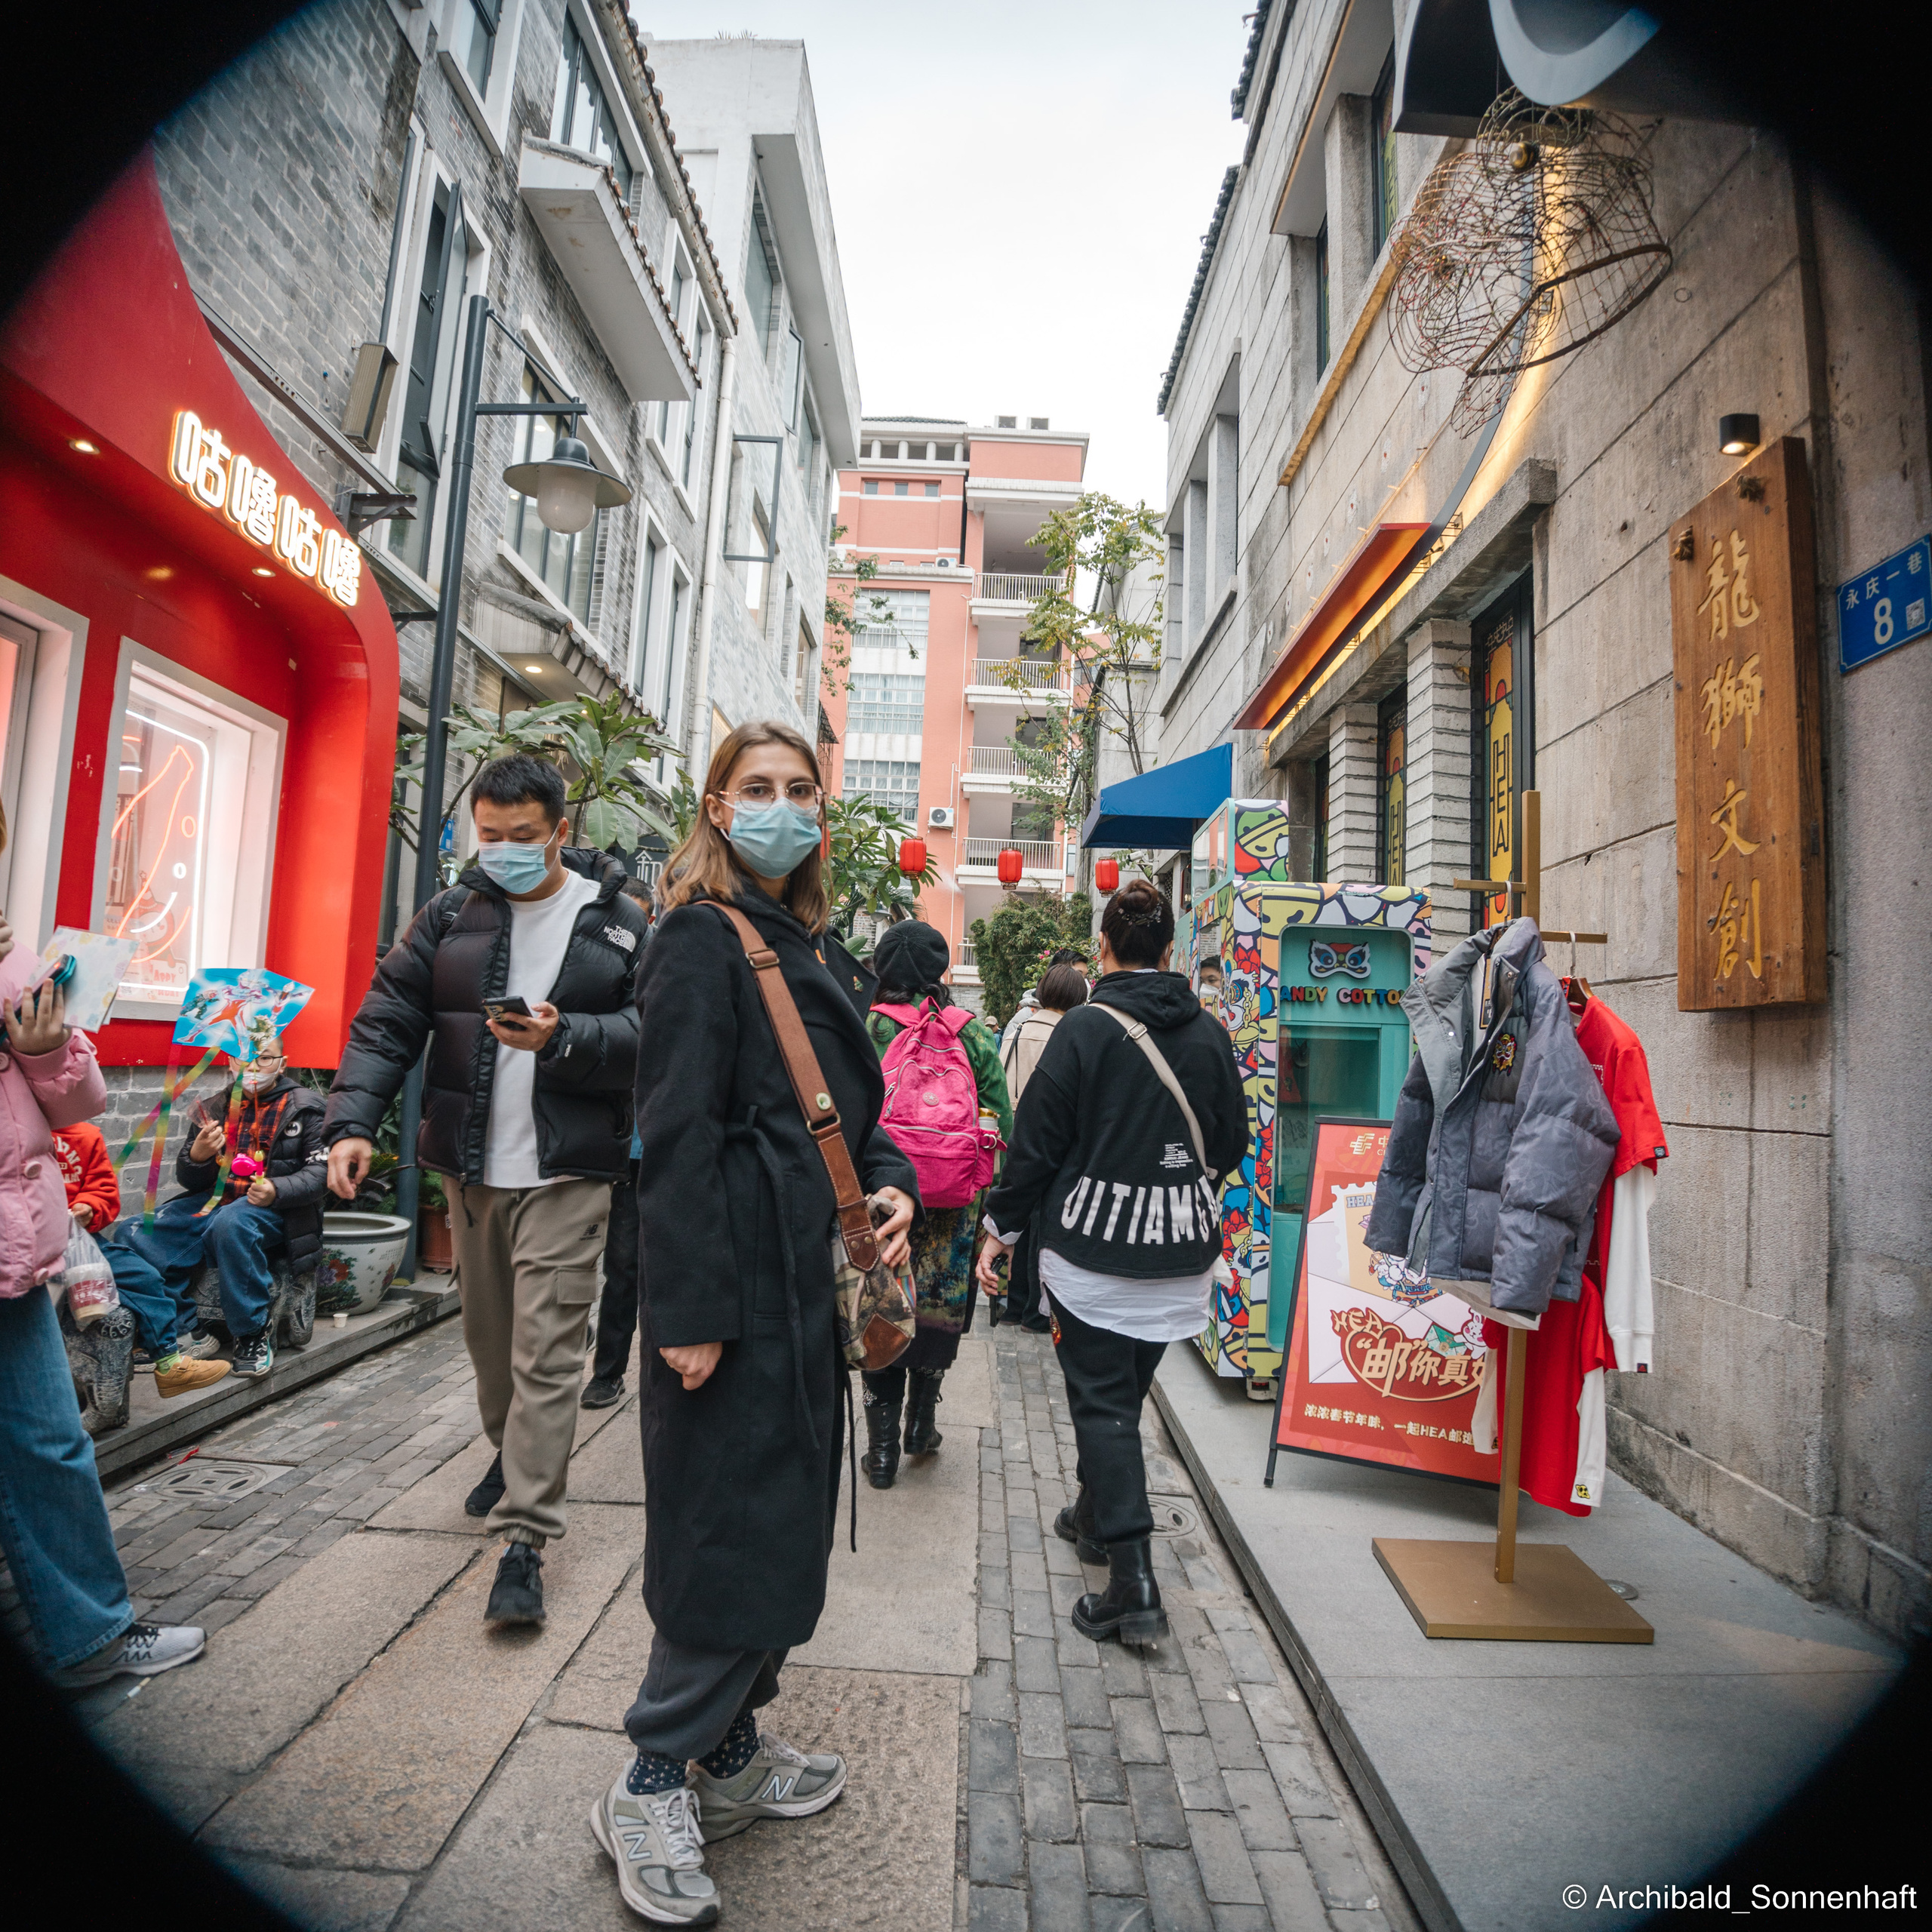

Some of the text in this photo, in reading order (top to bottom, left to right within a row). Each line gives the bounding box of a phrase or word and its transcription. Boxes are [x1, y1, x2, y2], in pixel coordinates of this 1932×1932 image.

[1846, 552, 1923, 610] 永庆一巷
[1874, 597, 1894, 645] 8
[1697, 529, 1762, 980] 龍獅文創
[1492, 733, 1509, 857] HEA
[604, 926, 626, 943] NORTH
[608, 936, 625, 947] FACE
[615, 924, 628, 936] THE
[148, 964, 176, 983] APPY
[1280, 986, 1328, 1002] ANDY
[1346, 1194, 1374, 1208] HEA
[1334, 1309, 1383, 1340] HEA
[759, 1774, 794, 1801] N
[623, 1832, 652, 1862] N
